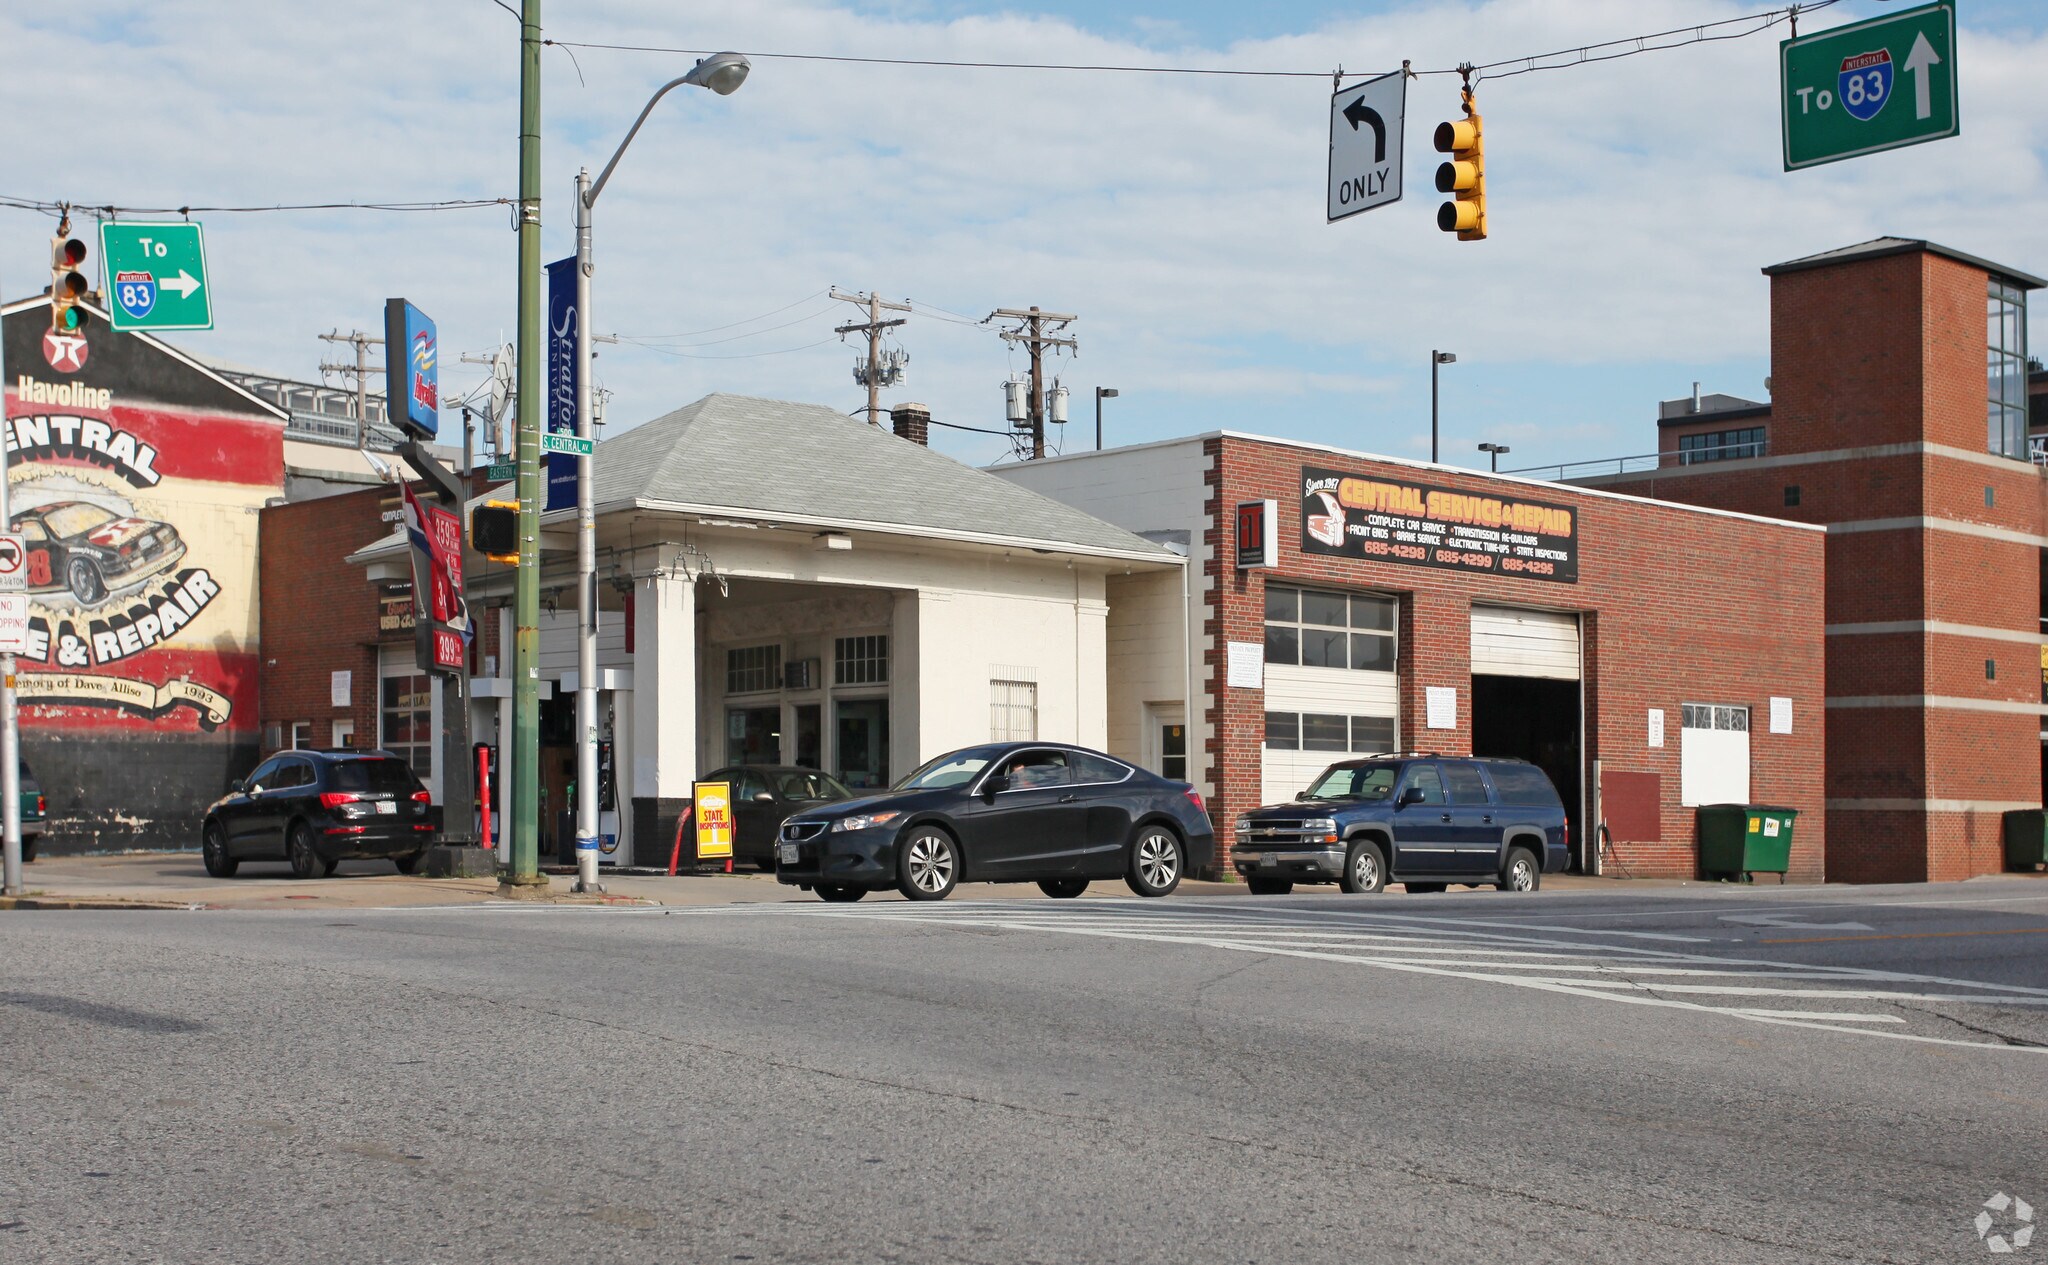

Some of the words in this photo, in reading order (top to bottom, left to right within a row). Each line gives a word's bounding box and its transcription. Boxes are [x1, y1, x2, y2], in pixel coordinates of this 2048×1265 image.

[1846, 53, 1884, 70] INTERSTATE
[1796, 86, 1833, 114] To
[1847, 70, 1884, 106] 83
[1339, 167, 1390, 205] ONLY
[139, 238, 168, 257] To
[120, 274, 150, 282] INTERSTATE
[122, 285, 151, 307] 83
[551, 294, 578, 430] Stratfor
[18, 375, 111, 410] Havoline
[543, 435, 550, 449] S.
[551, 437, 582, 452] CENTRAL
[489, 464, 513, 479] EASTERN
[1305, 478, 1324, 498] Since
[1338, 477, 1426, 518] CENTRAL
[1426, 490, 1503, 529] SERVICE
[1502, 504, 1514, 526] &
[1511, 503, 1572, 538] REPAIR
[1368, 514, 1405, 529] COMPLETE
[1406, 520, 1420, 531] CAR
[1422, 522, 1446, 534] SERVICE
[1453, 525, 1500, 542] TRANSMISSION
[1501, 533, 1538, 546] RE-BUILDERS
[1349, 525, 1371, 537] FRONT
[1371, 527, 1389, 539] ENDS
[1396, 531, 1417, 542] BRAKE
[1417, 533, 1440, 545] SERVICE
[1449, 538, 1482, 551] ELECTRONIC
[1483, 542, 1510, 554] TUNE-UPS
[1516, 546, 1534, 557] STATE
[1534, 548, 1568, 561] INSPECTIONS
[1364, 541, 1426, 560] 685-4298
[1435, 550, 1493, 568] 685-4299
[1501, 558, 1554, 575] 685-4295
[13, 577, 24, 585] TON
[1, 601, 12, 611] NO
[58, 635, 88, 666] &
[92, 569, 221, 666] REPAIR
[440, 636, 455, 662] 399
[15, 679, 53, 691] emory
[57, 678, 70, 688] of
[74, 678, 103, 690] Dave
[110, 681, 142, 698] Alliso
[182, 685, 214, 704] 1993
[704, 810, 723, 821] STATE
[699, 822, 729, 830] INSPECTIONS
